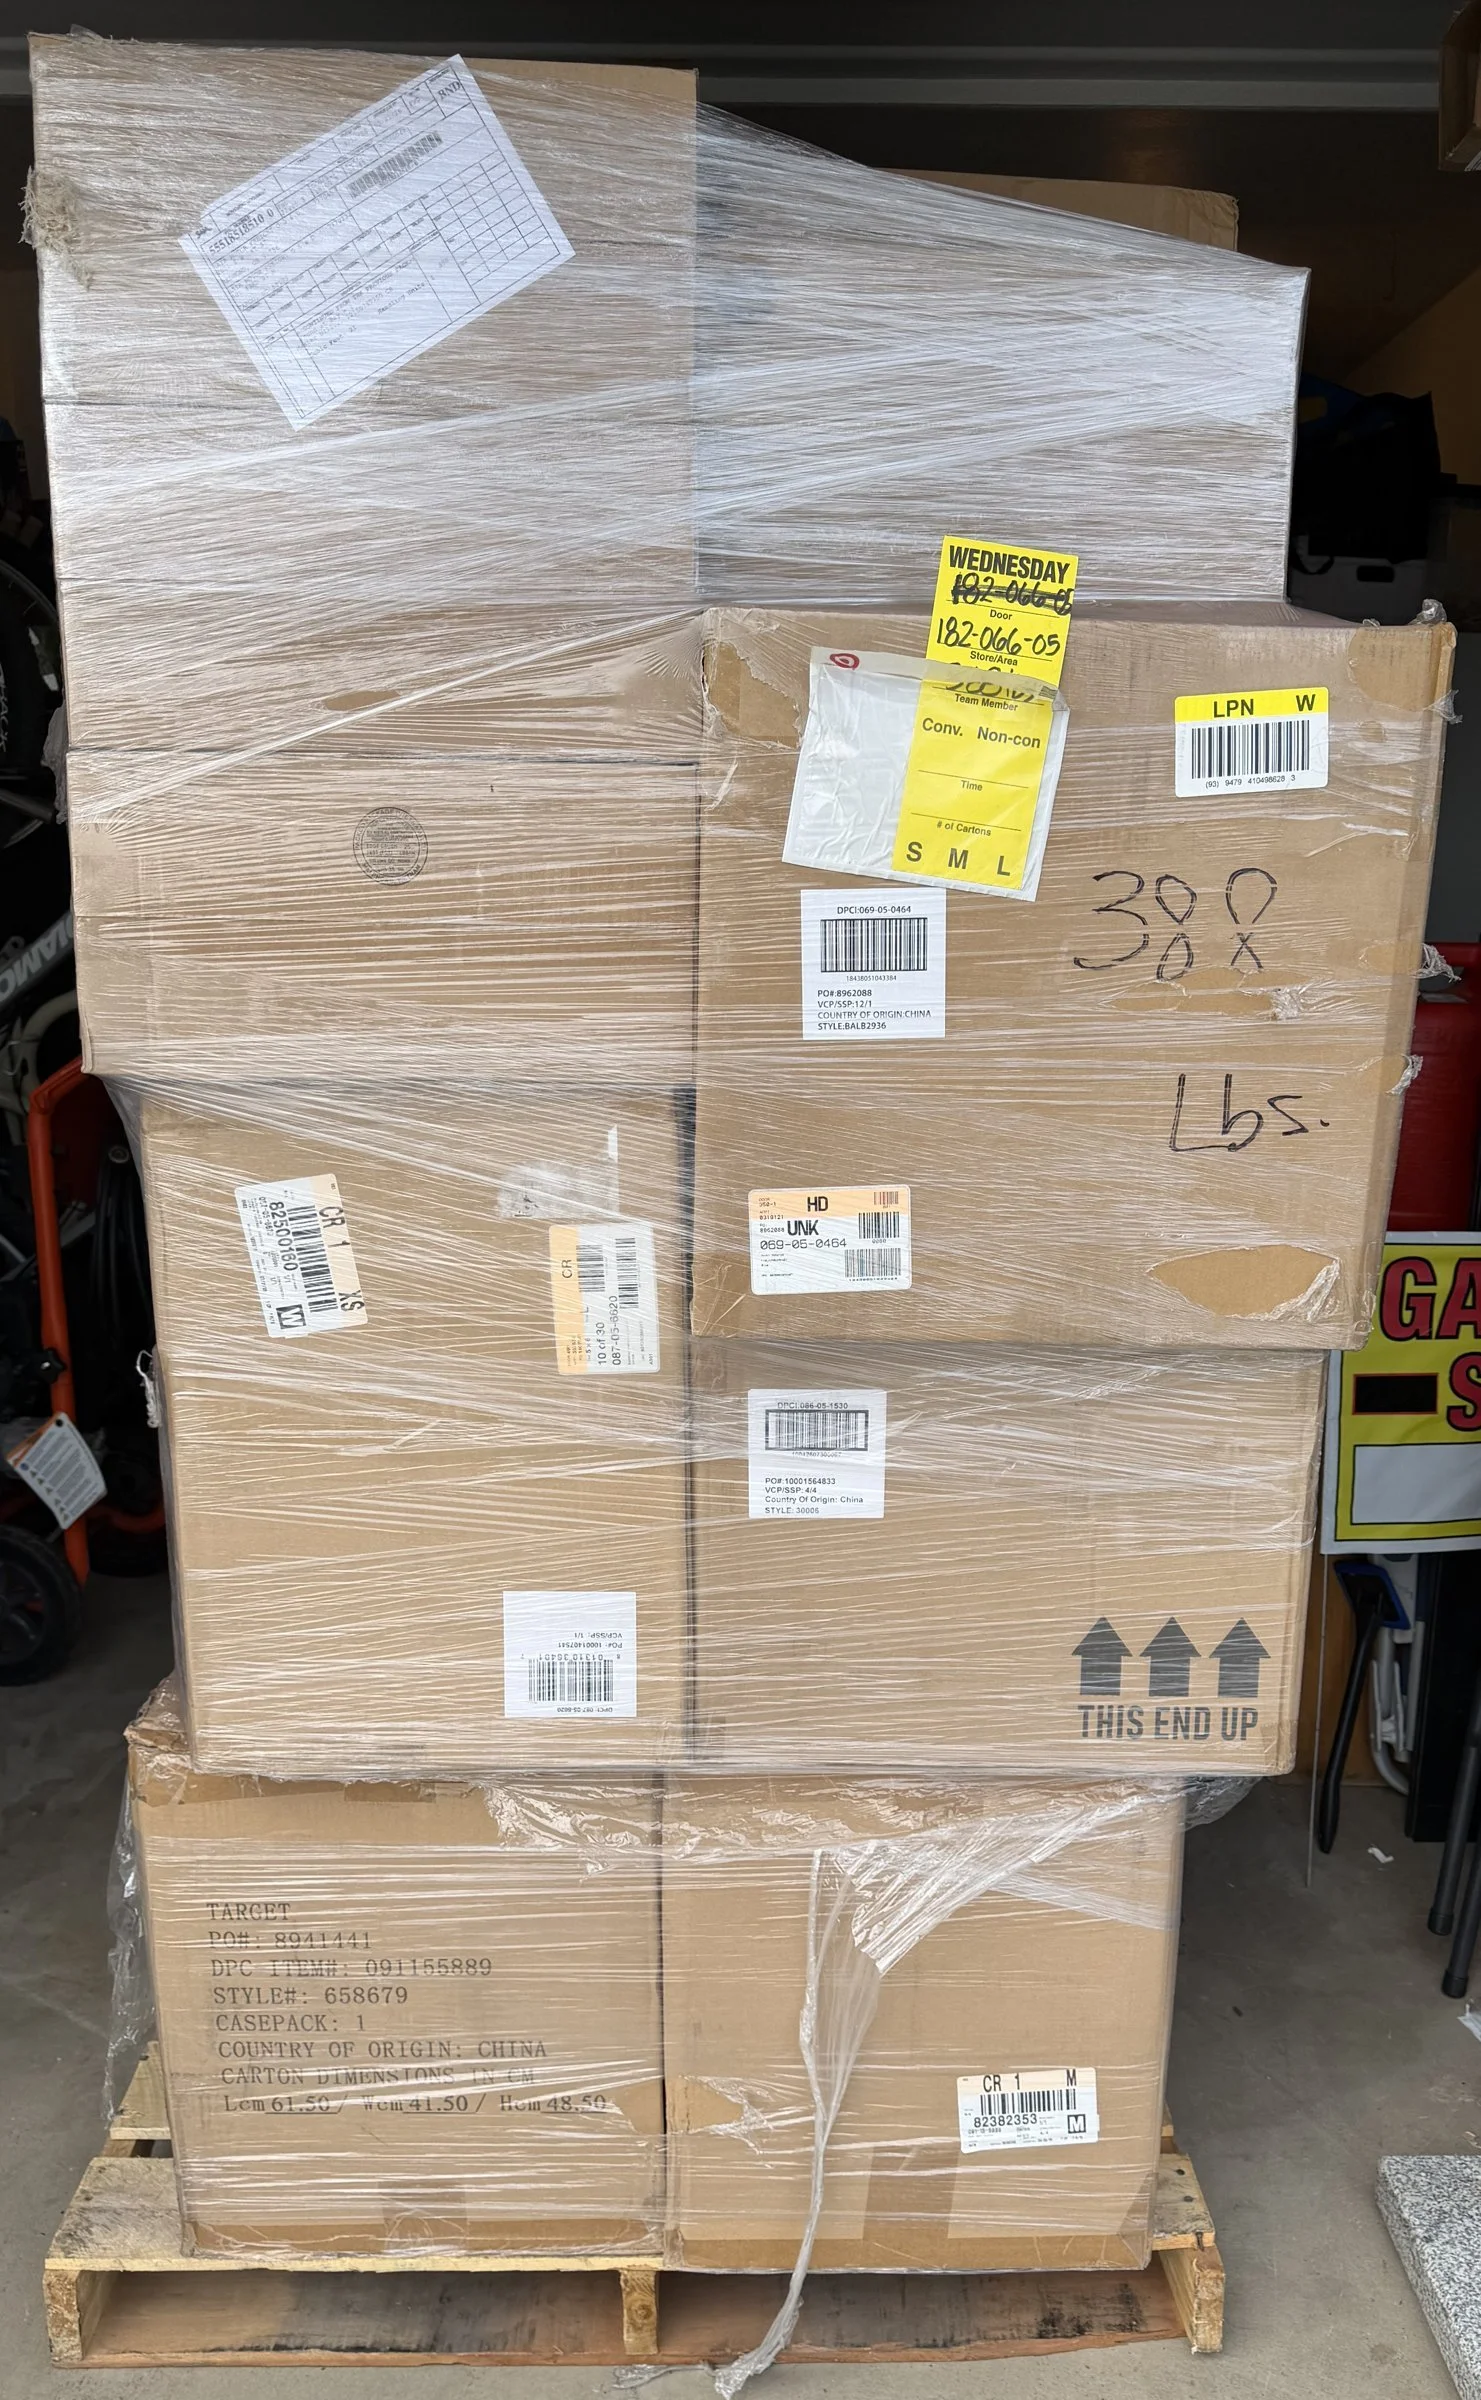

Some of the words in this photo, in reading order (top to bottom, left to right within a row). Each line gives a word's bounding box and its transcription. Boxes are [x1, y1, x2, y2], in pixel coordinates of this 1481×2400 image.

[438, 80, 461, 100] RND
[949, 545, 1070, 584] WEDNESDAY
[990, 609, 1013, 621] Door
[937, 616, 1060, 656] 182-066-05
[970, 650, 1018, 666] Store/Area
[955, 693, 980, 706] Team
[982, 697, 1018, 712] Member
[1213, 699, 1254, 718] LPN
[1296, 694, 1316, 711] W
[922, 718, 964, 739] Conv.
[977, 726, 1041, 749] Non-con
[961, 779, 983, 792] Time
[1206, 780, 1219, 789] (93)
[956, 822, 992, 837] Cartons
[906, 841, 923, 862] S
[948, 848, 968, 870] M
[997, 855, 1011, 877] L
[837, 906, 911, 914] DPCI:069-05-0464
[1073, 867, 1278, 982] 388
[817, 989, 872, 998] PO#:8962088
[817, 1000, 872, 1009] VCP/SSP:12/1
[817, 1011, 858, 1019] COUNTRY
[860, 1011, 870, 1019] OF
[873, 1010, 931, 1019] ORIGIN:CHINA
[807, 1196, 829, 1212] HD
[318, 1206, 346, 1229] CR
[268, 1201, 299, 1271] 82500160
[787, 1219, 819, 1236] UNK
[328, 1239, 351, 1248] 1
[759, 1238, 847, 1250] 069-05-0464
[561, 1259, 573, 1279] CR
[338, 1290, 365, 1312] XS
[1379, 1256, 1481, 1342] GA
[596, 1321, 606, 1336] 30
[598, 1337, 607, 1350] of
[598, 1351, 607, 1365] 10
[765, 1496, 796, 1504] Country
[1077, 1704, 1144, 1740] THIS
[1154, 1707, 1211, 1740] END
[1221, 1707, 1259, 1741] UP
[206, 1903, 291, 1921] TARGET
[208, 1931, 262, 1950] PO#:
[275, 1931, 372, 1950] 8941441
[211, 1959, 253, 1977] DPC
[365, 1957, 492, 1976] 091155889
[213, 1986, 309, 2005] STYLE#:
[324, 1986, 408, 2005] 658679
[216, 2014, 339, 2032] CASEPACK:
[356, 2014, 366, 2032] 1
[218, 2041, 318, 2059] COUNTRY
[328, 2041, 355, 2058] OF
[368, 2040, 463, 2059] ORIGIN:
[477, 2040, 547, 2058] CHINA
[221, 2067, 304, 2085] CARTON
[317, 2066, 455, 2084] DIMENSIONS
[471, 2066, 495, 2084] IN
[507, 2066, 535, 2084] CM
[983, 2074, 1002, 2092] CR
[1014, 2074, 1020, 2090] 1
[1066, 2069, 1077, 2086] M
[974, 2113, 1038, 2128] 82382353
[1068, 2114, 1086, 2134] M
